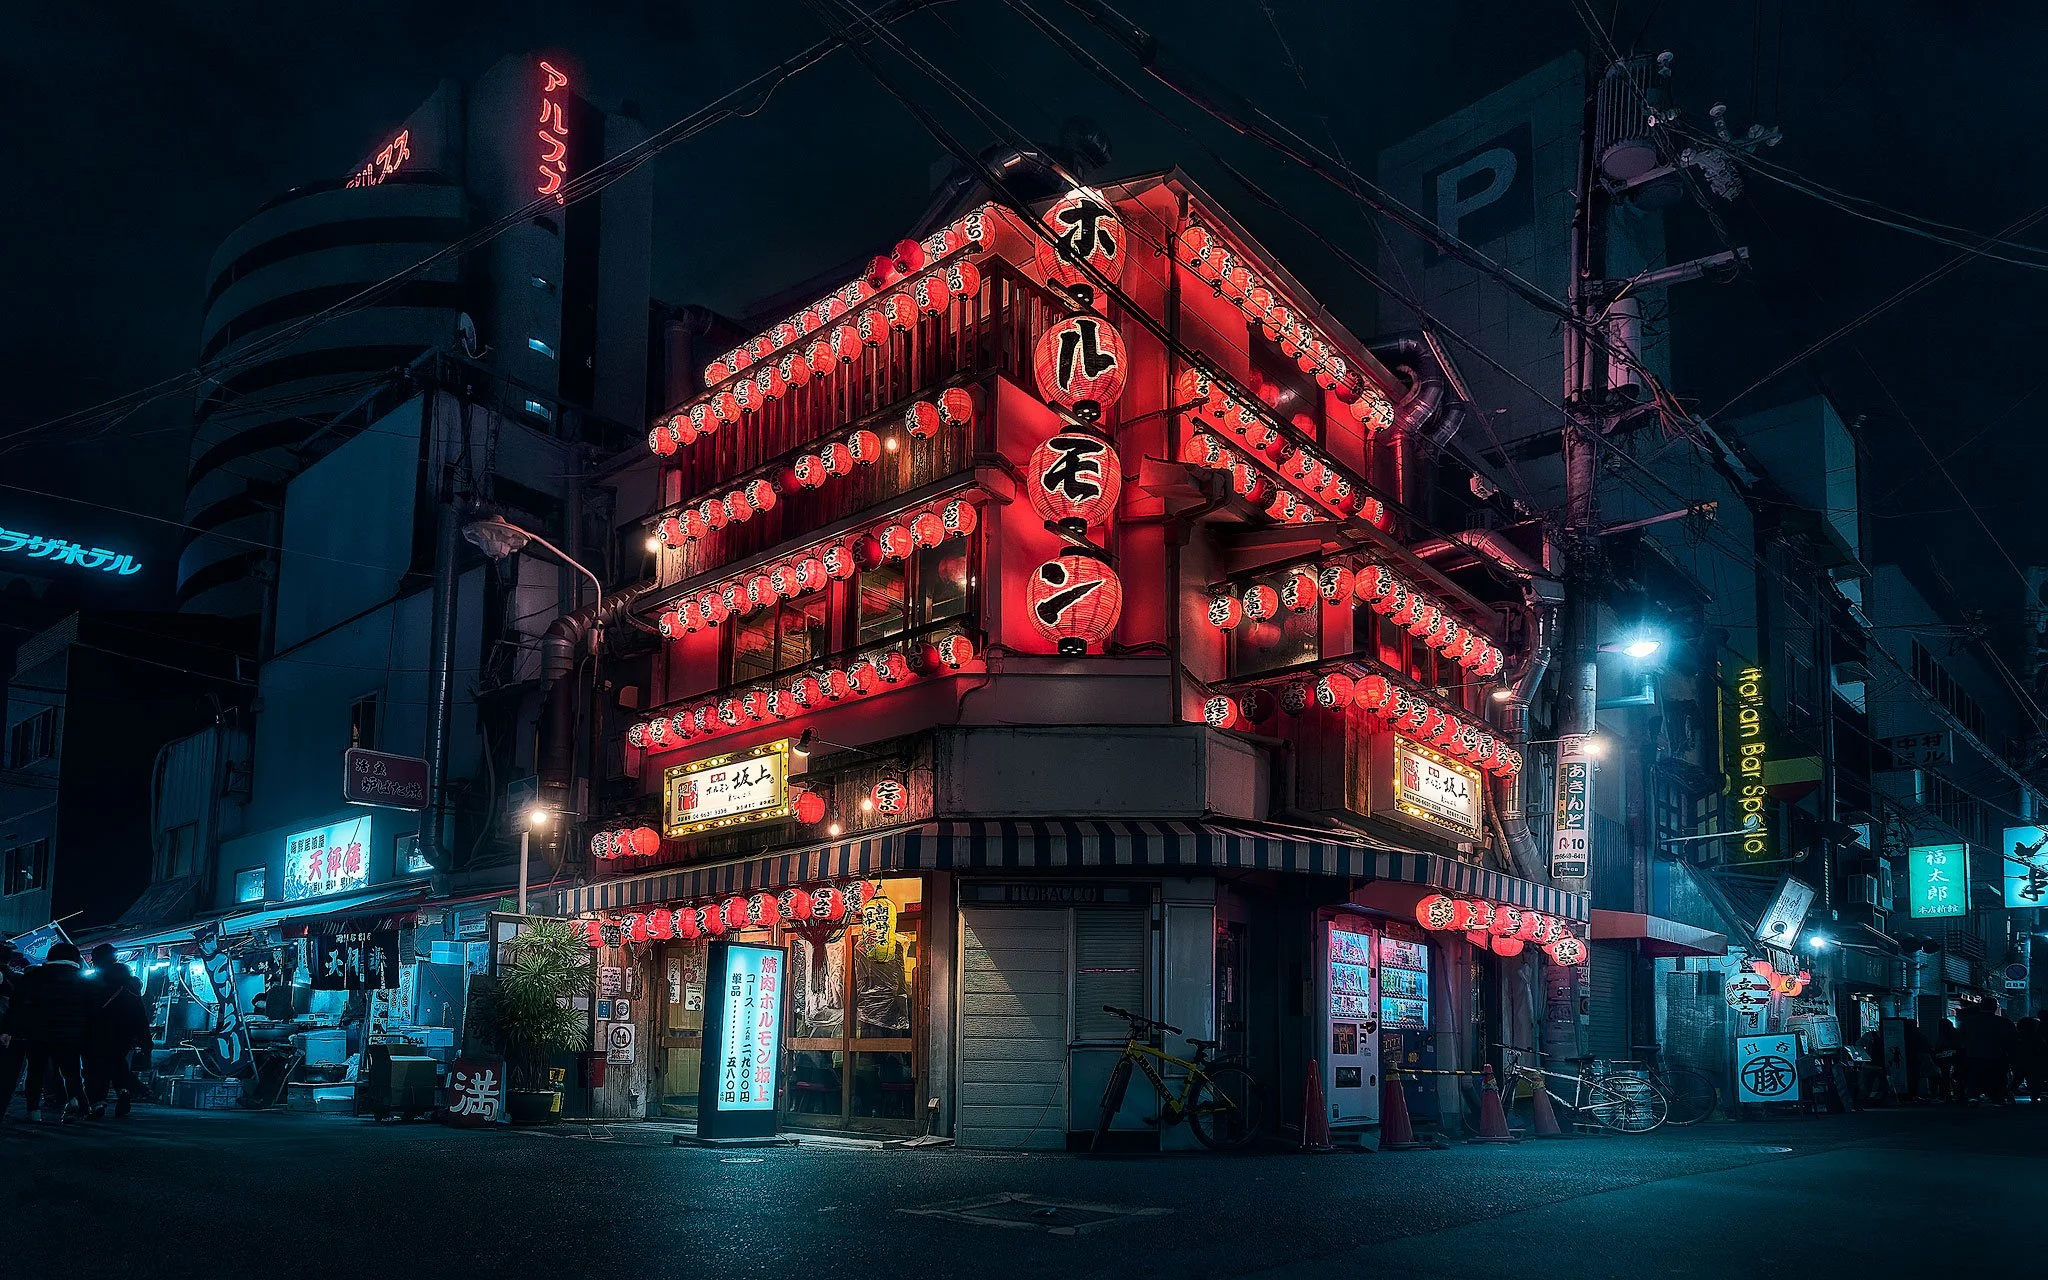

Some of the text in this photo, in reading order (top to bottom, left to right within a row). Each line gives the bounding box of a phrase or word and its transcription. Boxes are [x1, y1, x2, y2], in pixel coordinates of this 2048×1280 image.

[1437, 147, 1517, 256] P
[1034, 196, 1118, 628] ホルモン
[0, 527, 142, 575] ラザホテル
[732, 763, 771, 790] 坂上
[1741, 743, 1766, 779] Bar
[1566, 764, 1586, 829] あきんど
[1571, 838, 1585, 850] 10
[1925, 850, 1950, 902] 福太郎
[730, 973, 742, 997] 単品
[744, 974, 756, 1008] コース
[754, 956, 777, 1102] 焼肉ホルモン坂上
[449, 1069, 500, 1123] 満
